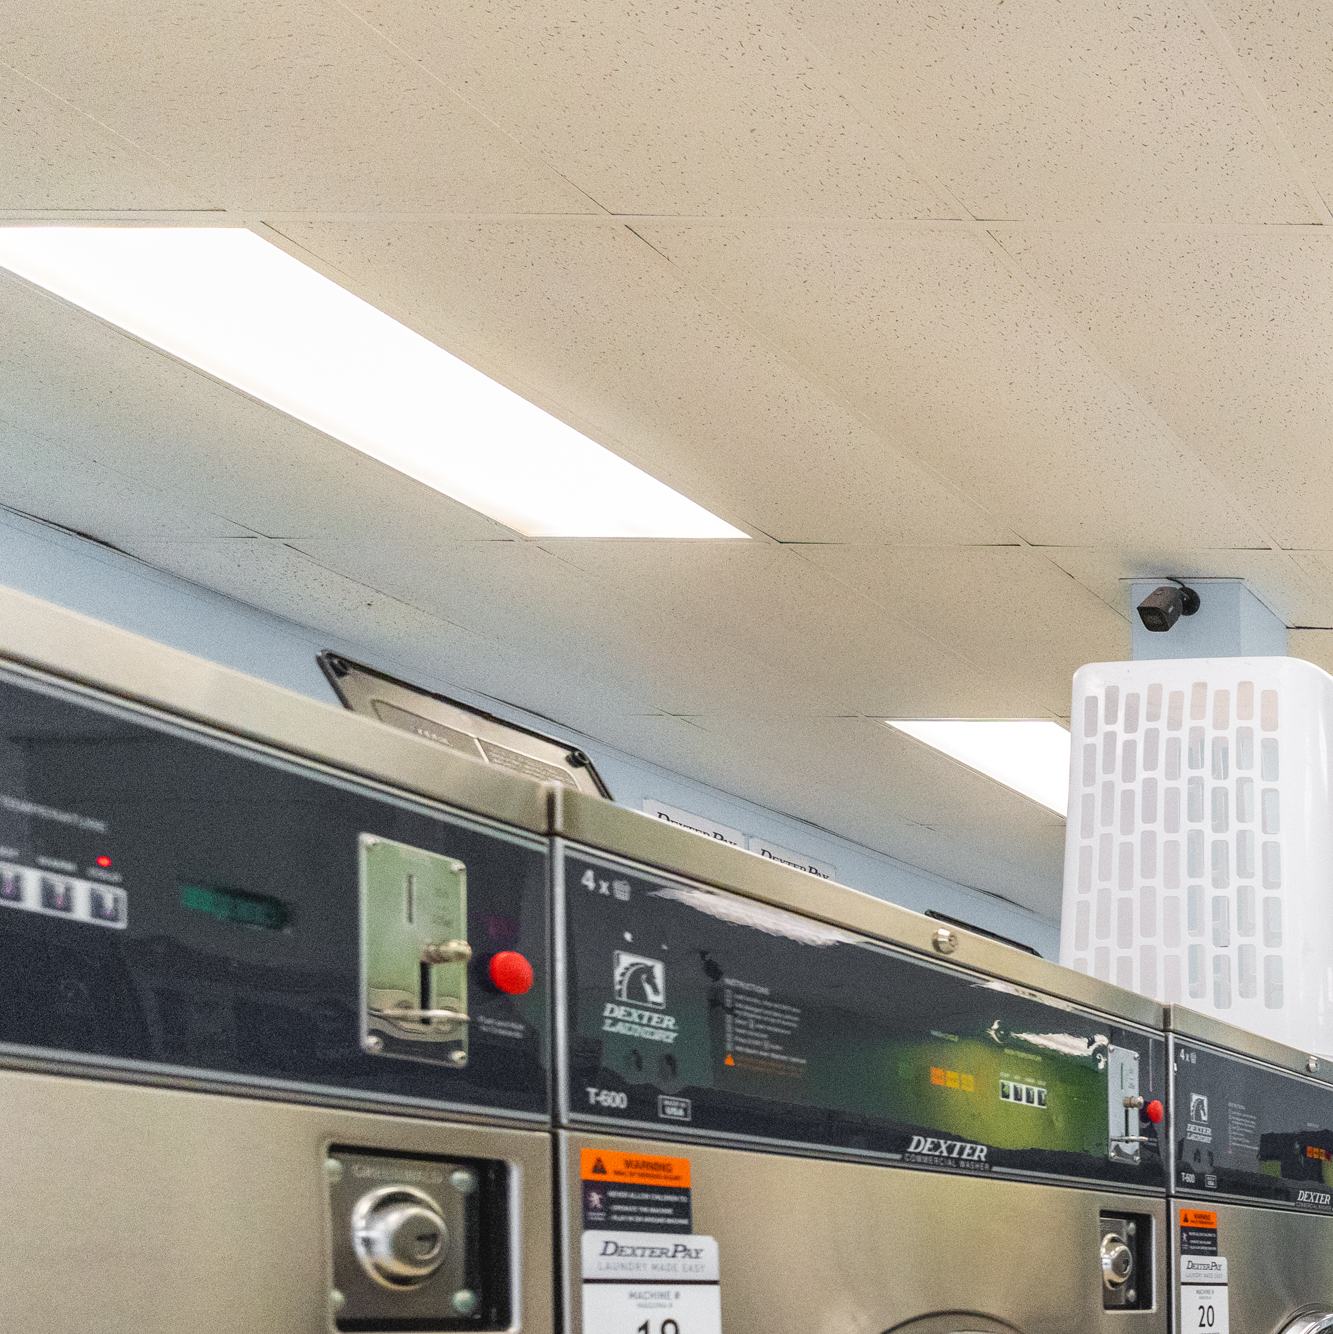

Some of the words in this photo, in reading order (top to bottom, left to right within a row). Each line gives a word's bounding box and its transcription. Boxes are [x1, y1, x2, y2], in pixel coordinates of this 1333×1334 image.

[581, 869, 595, 891] 4
[599, 880, 610, 896] x
[603, 1003, 677, 1030] DEXTER
[603, 1019, 678, 1043] LAUNDRY
[1180, 1049, 1185, 1058] 4
[586, 1087, 628, 1109] T-600
[665, 1106, 685, 1117] USA
[1186, 1123, 1212, 1135] DEXTER
[907, 1136, 988, 1162] DEXTER
[624, 1159, 673, 1173] WARNING
[904, 1154, 957, 1168] COMMERCIAL
[959, 1159, 990, 1171] WASHER
[1181, 1172, 1196, 1184] T-600
[1297, 1190, 1331, 1205] DEXTER
[600, 1241, 704, 1259] DEXTERPAY
[599, 1261, 646, 1271] LAUNDRY
[651, 1263, 677, 1272] MADE
[682, 1263, 705, 1273] EASY
[1186, 1261, 1222, 1271] DEXTERPAY
[629, 1291, 671, 1300] MACHINE
[1198, 1305, 1215, 1328] 20
